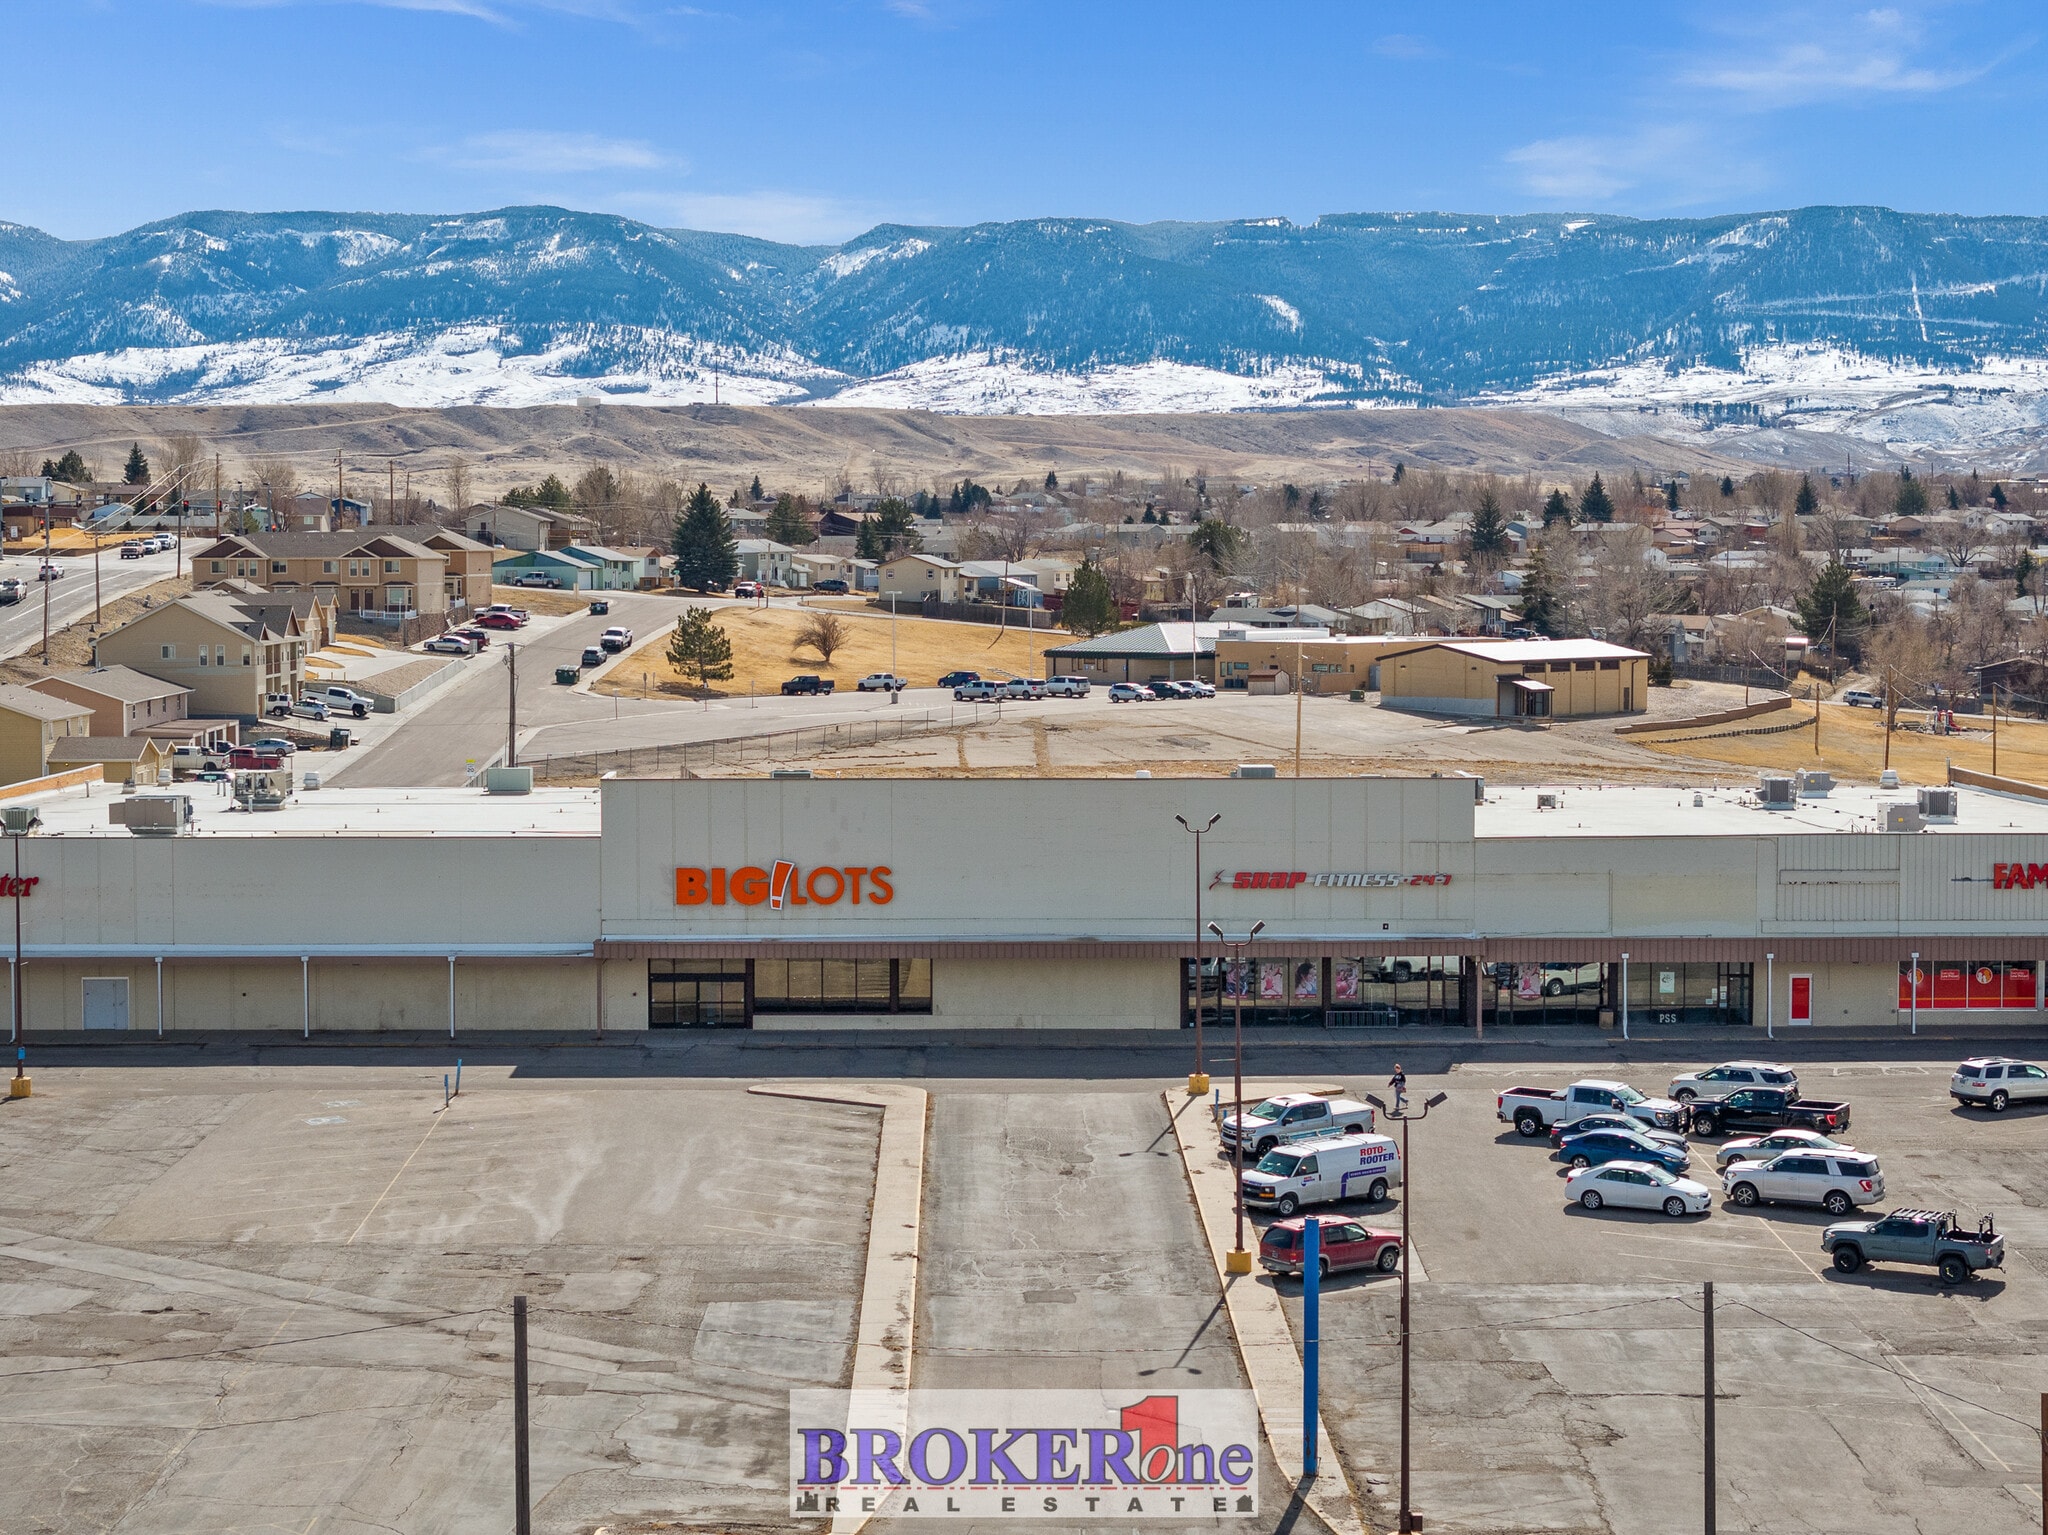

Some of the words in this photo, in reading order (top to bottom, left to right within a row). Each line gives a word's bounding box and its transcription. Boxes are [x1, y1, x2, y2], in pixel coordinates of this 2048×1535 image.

[1313, 873, 1402, 887] FITNESS
[1659, 1013, 1677, 1023] PSS
[1360, 1145, 1387, 1156] ROTO-
[1360, 1152, 1394, 1165] ROOTER
